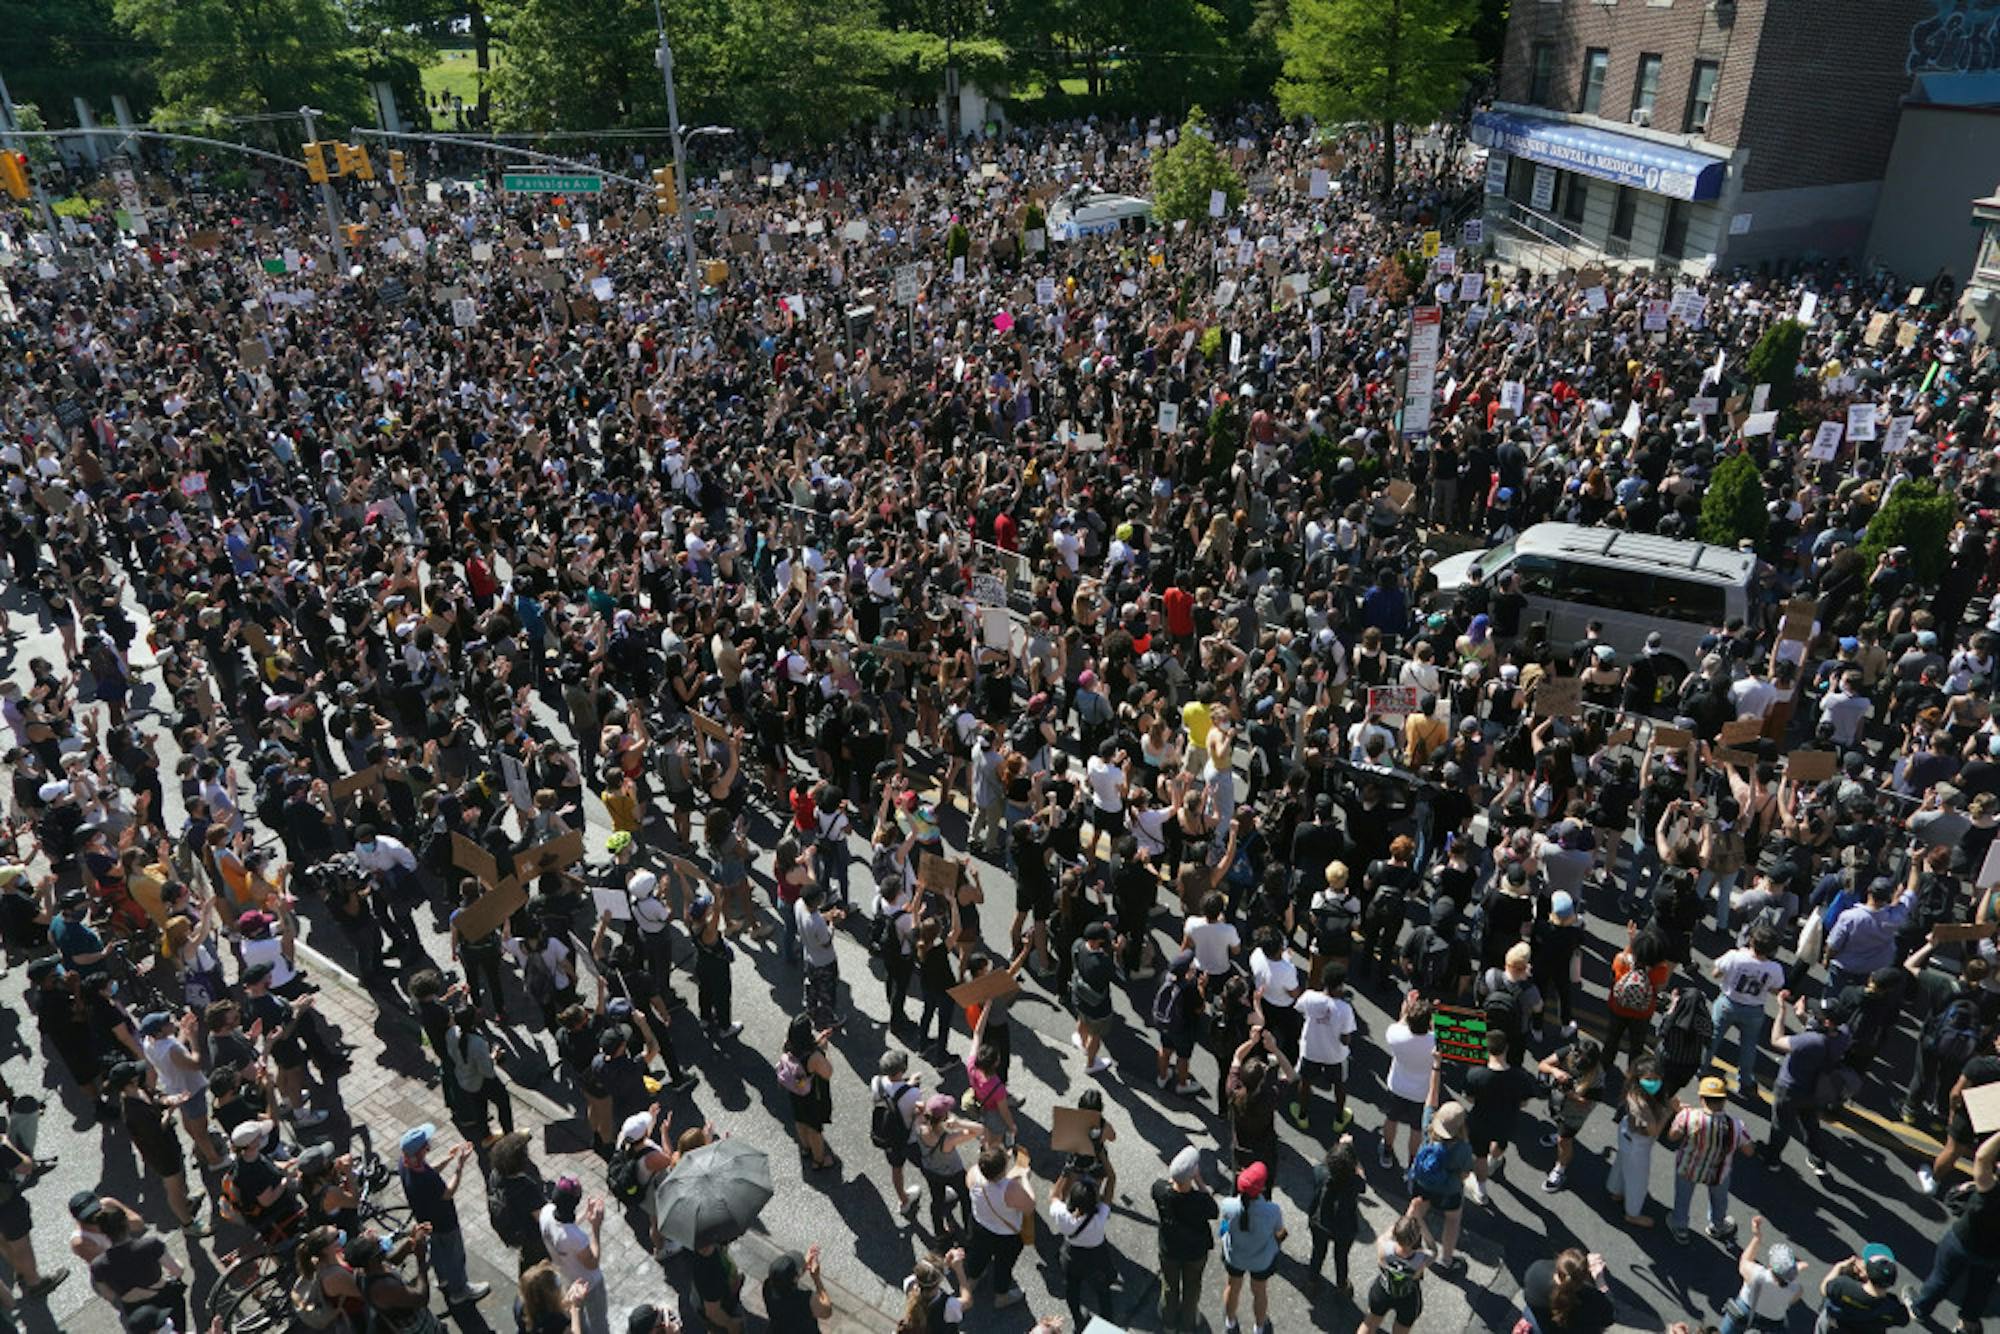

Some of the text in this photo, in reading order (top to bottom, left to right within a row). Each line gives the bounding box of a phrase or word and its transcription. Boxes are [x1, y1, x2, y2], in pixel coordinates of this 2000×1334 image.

[1551, 144, 1587, 164] DENTAL
[1597, 155, 1645, 178] MEDICAL
[515, 178, 571, 189] Parkside
